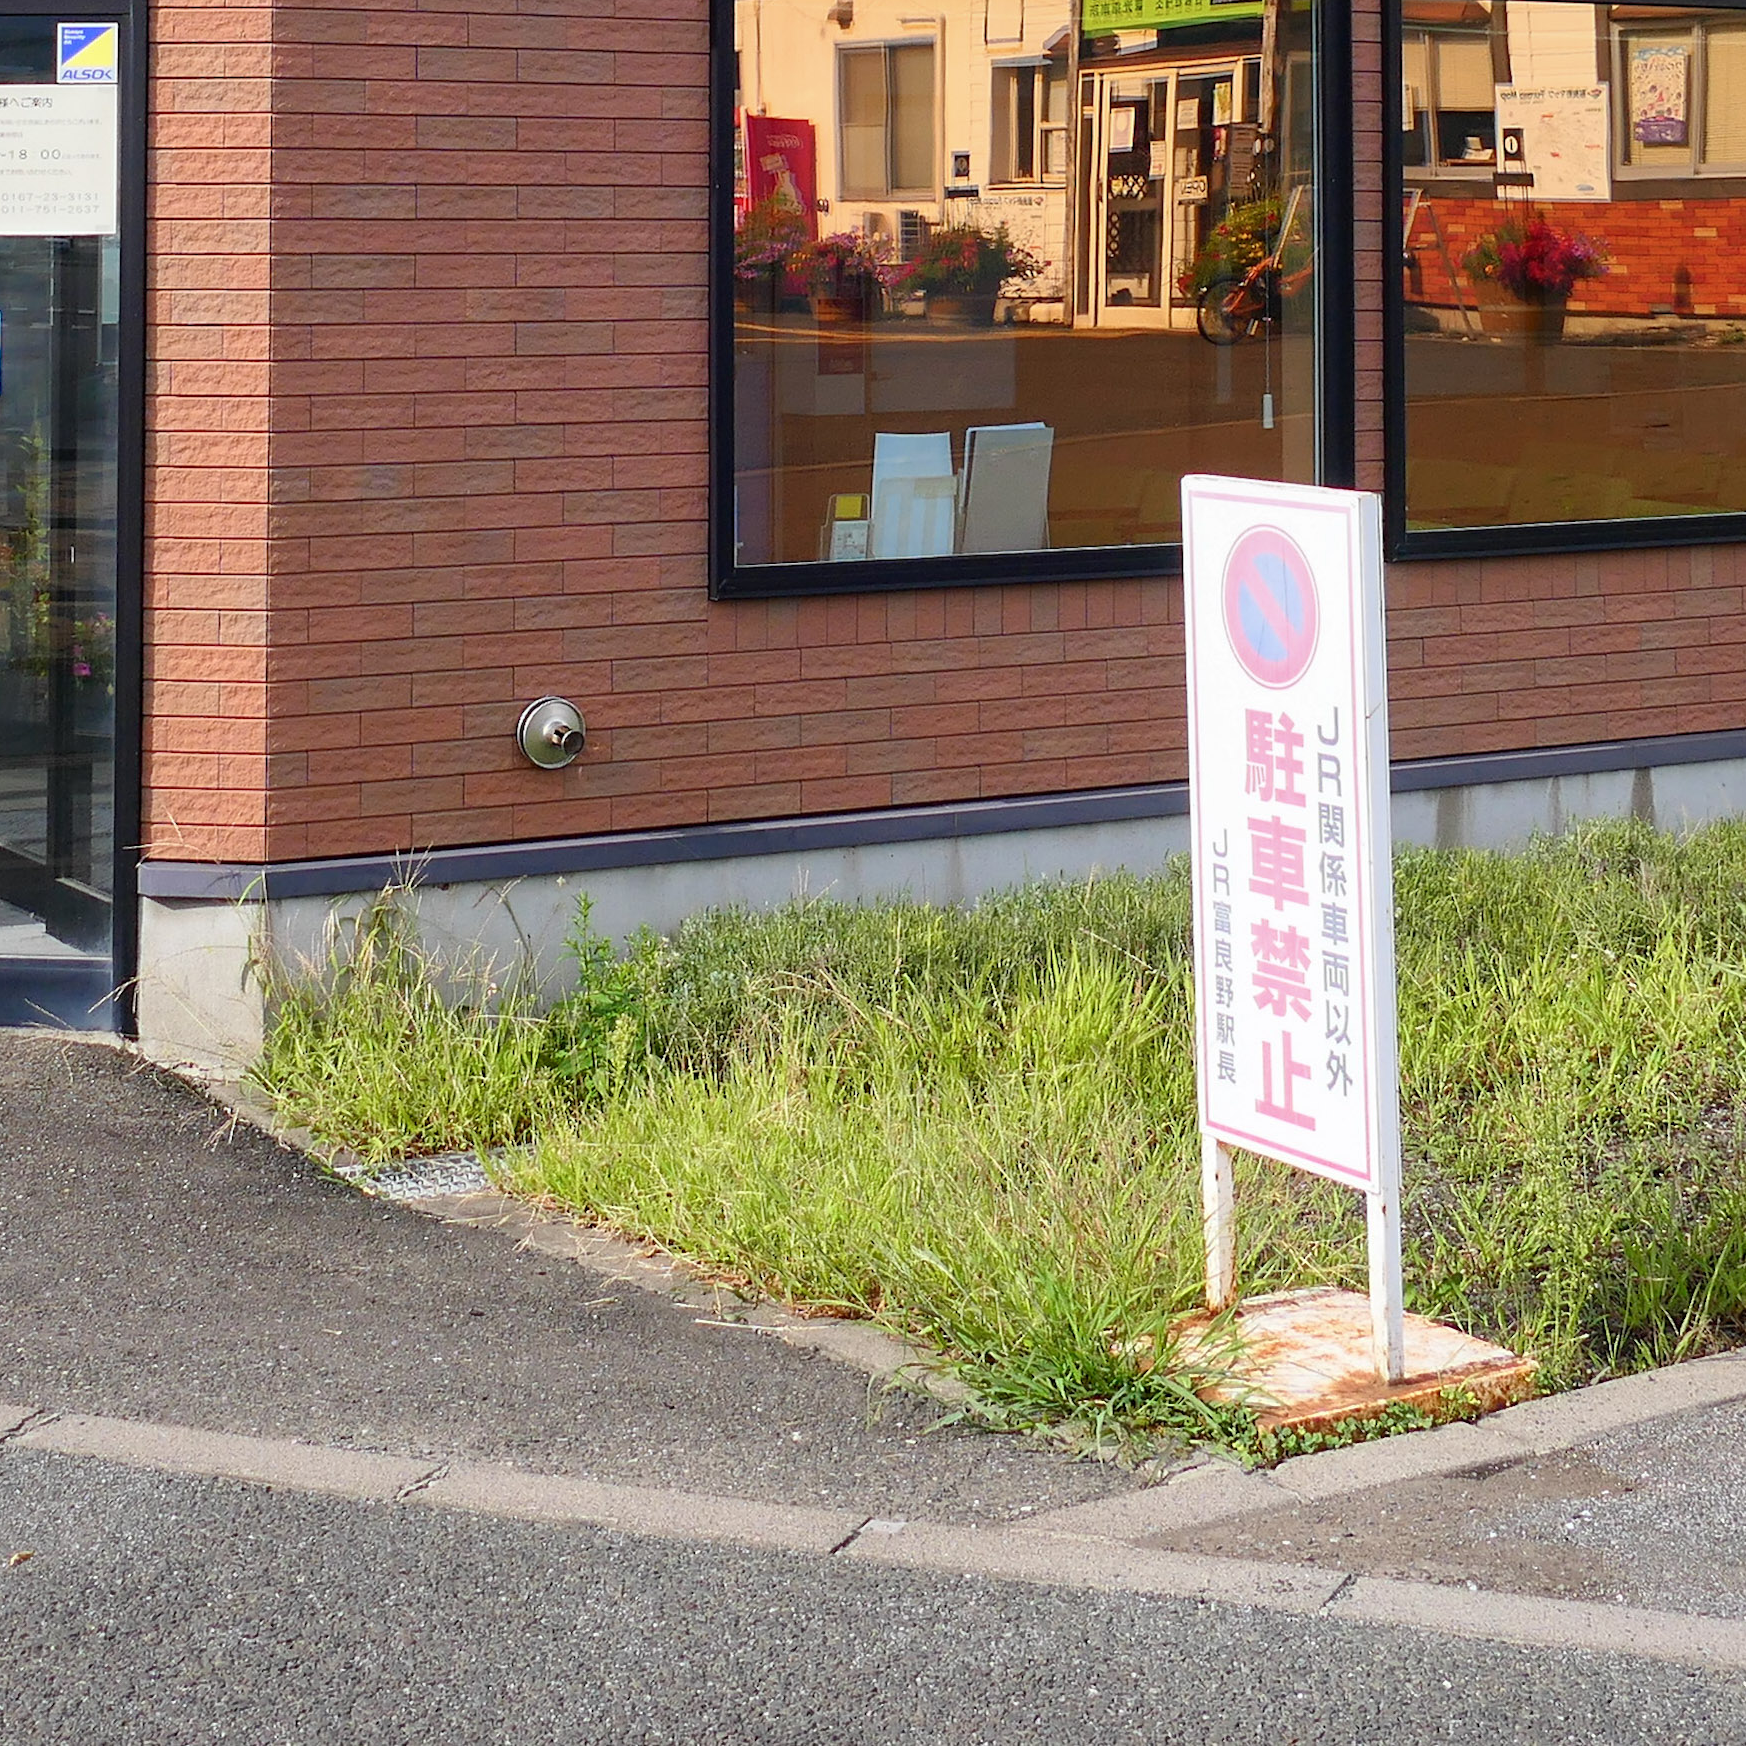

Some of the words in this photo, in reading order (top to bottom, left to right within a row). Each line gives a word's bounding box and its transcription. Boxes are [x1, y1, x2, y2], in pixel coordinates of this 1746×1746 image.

[62, 69, 112, 80] ALSOK
[1244, 708, 1317, 1133] 駐車禁止
